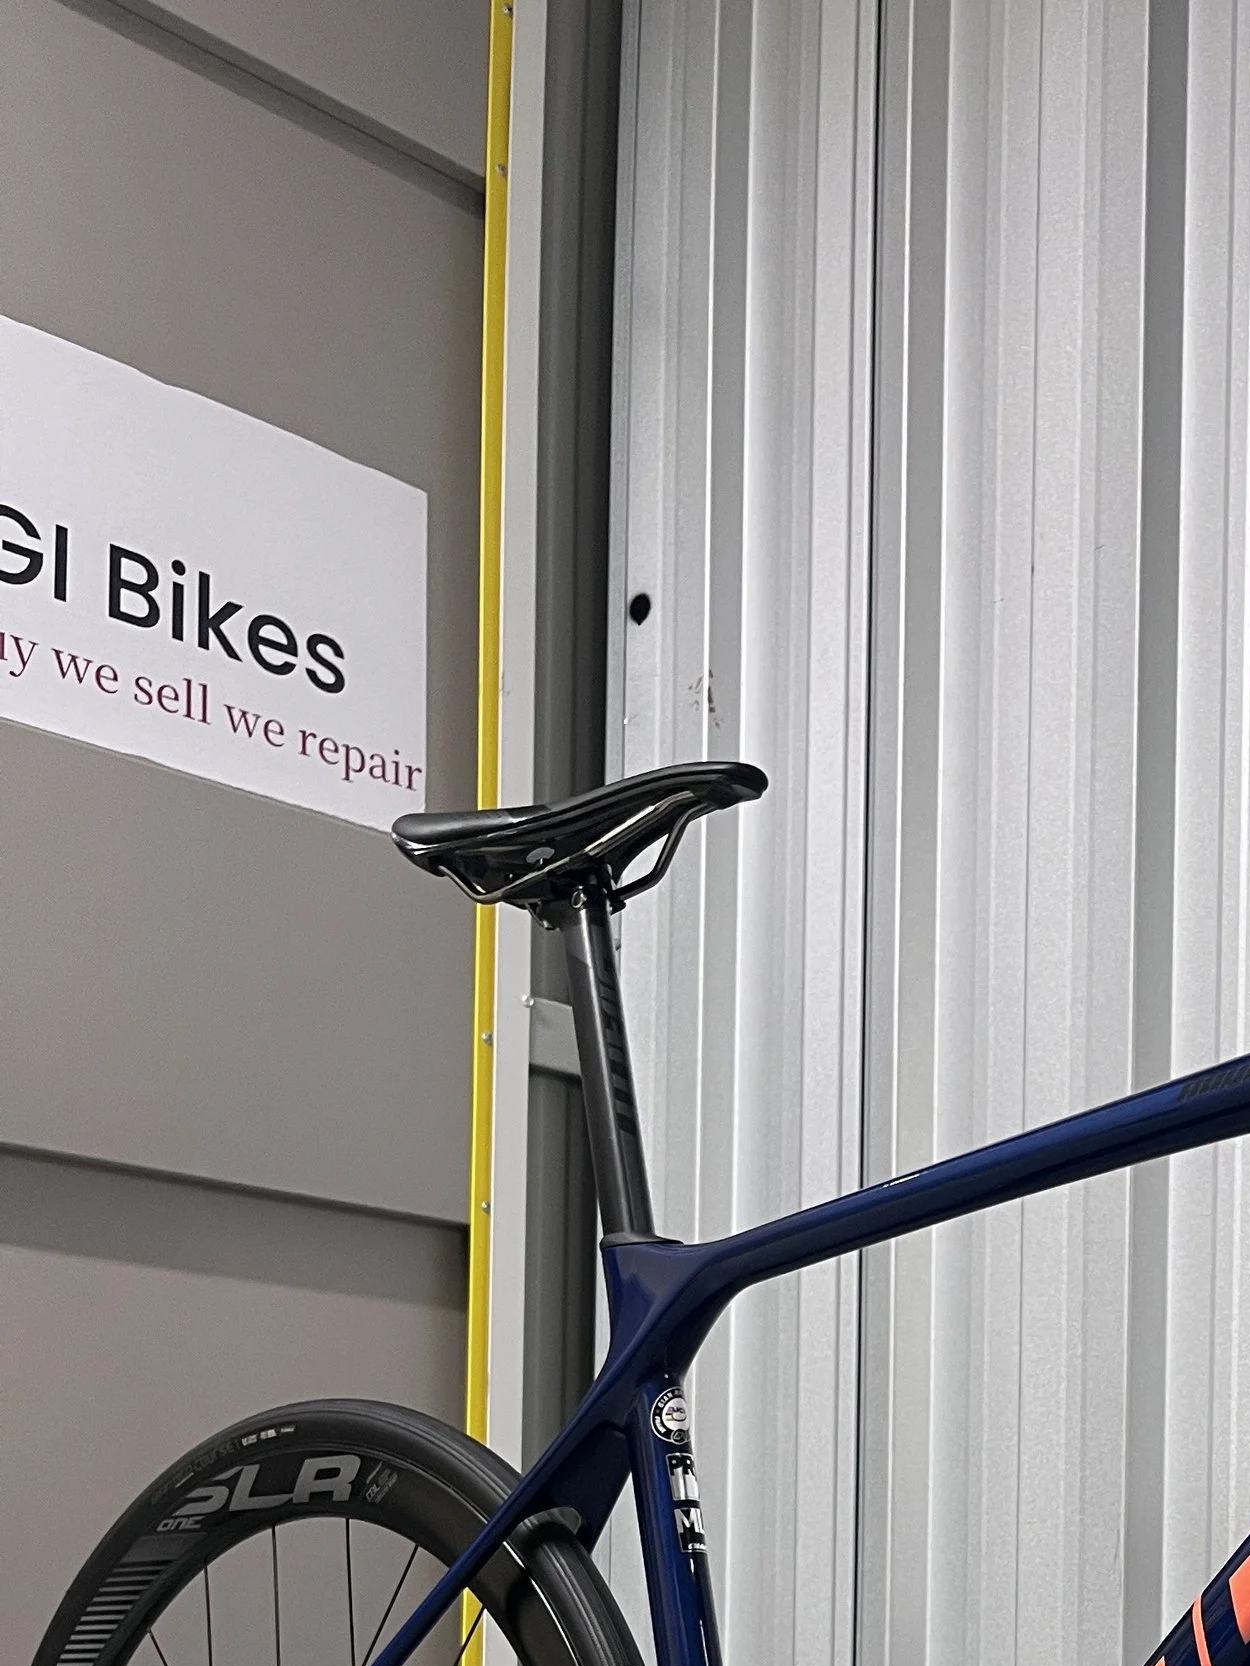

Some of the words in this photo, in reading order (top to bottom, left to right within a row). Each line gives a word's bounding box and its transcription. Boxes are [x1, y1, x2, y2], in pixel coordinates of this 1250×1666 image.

[108, 544, 346, 694] Bikes
[51, 647, 120, 694] we
[133, 674, 212, 726] sell
[224, 702, 286, 748] we
[298, 727, 423, 792] repair
[156, 1516, 206, 1532] ONE
[171, 1454, 362, 1517] SLR
